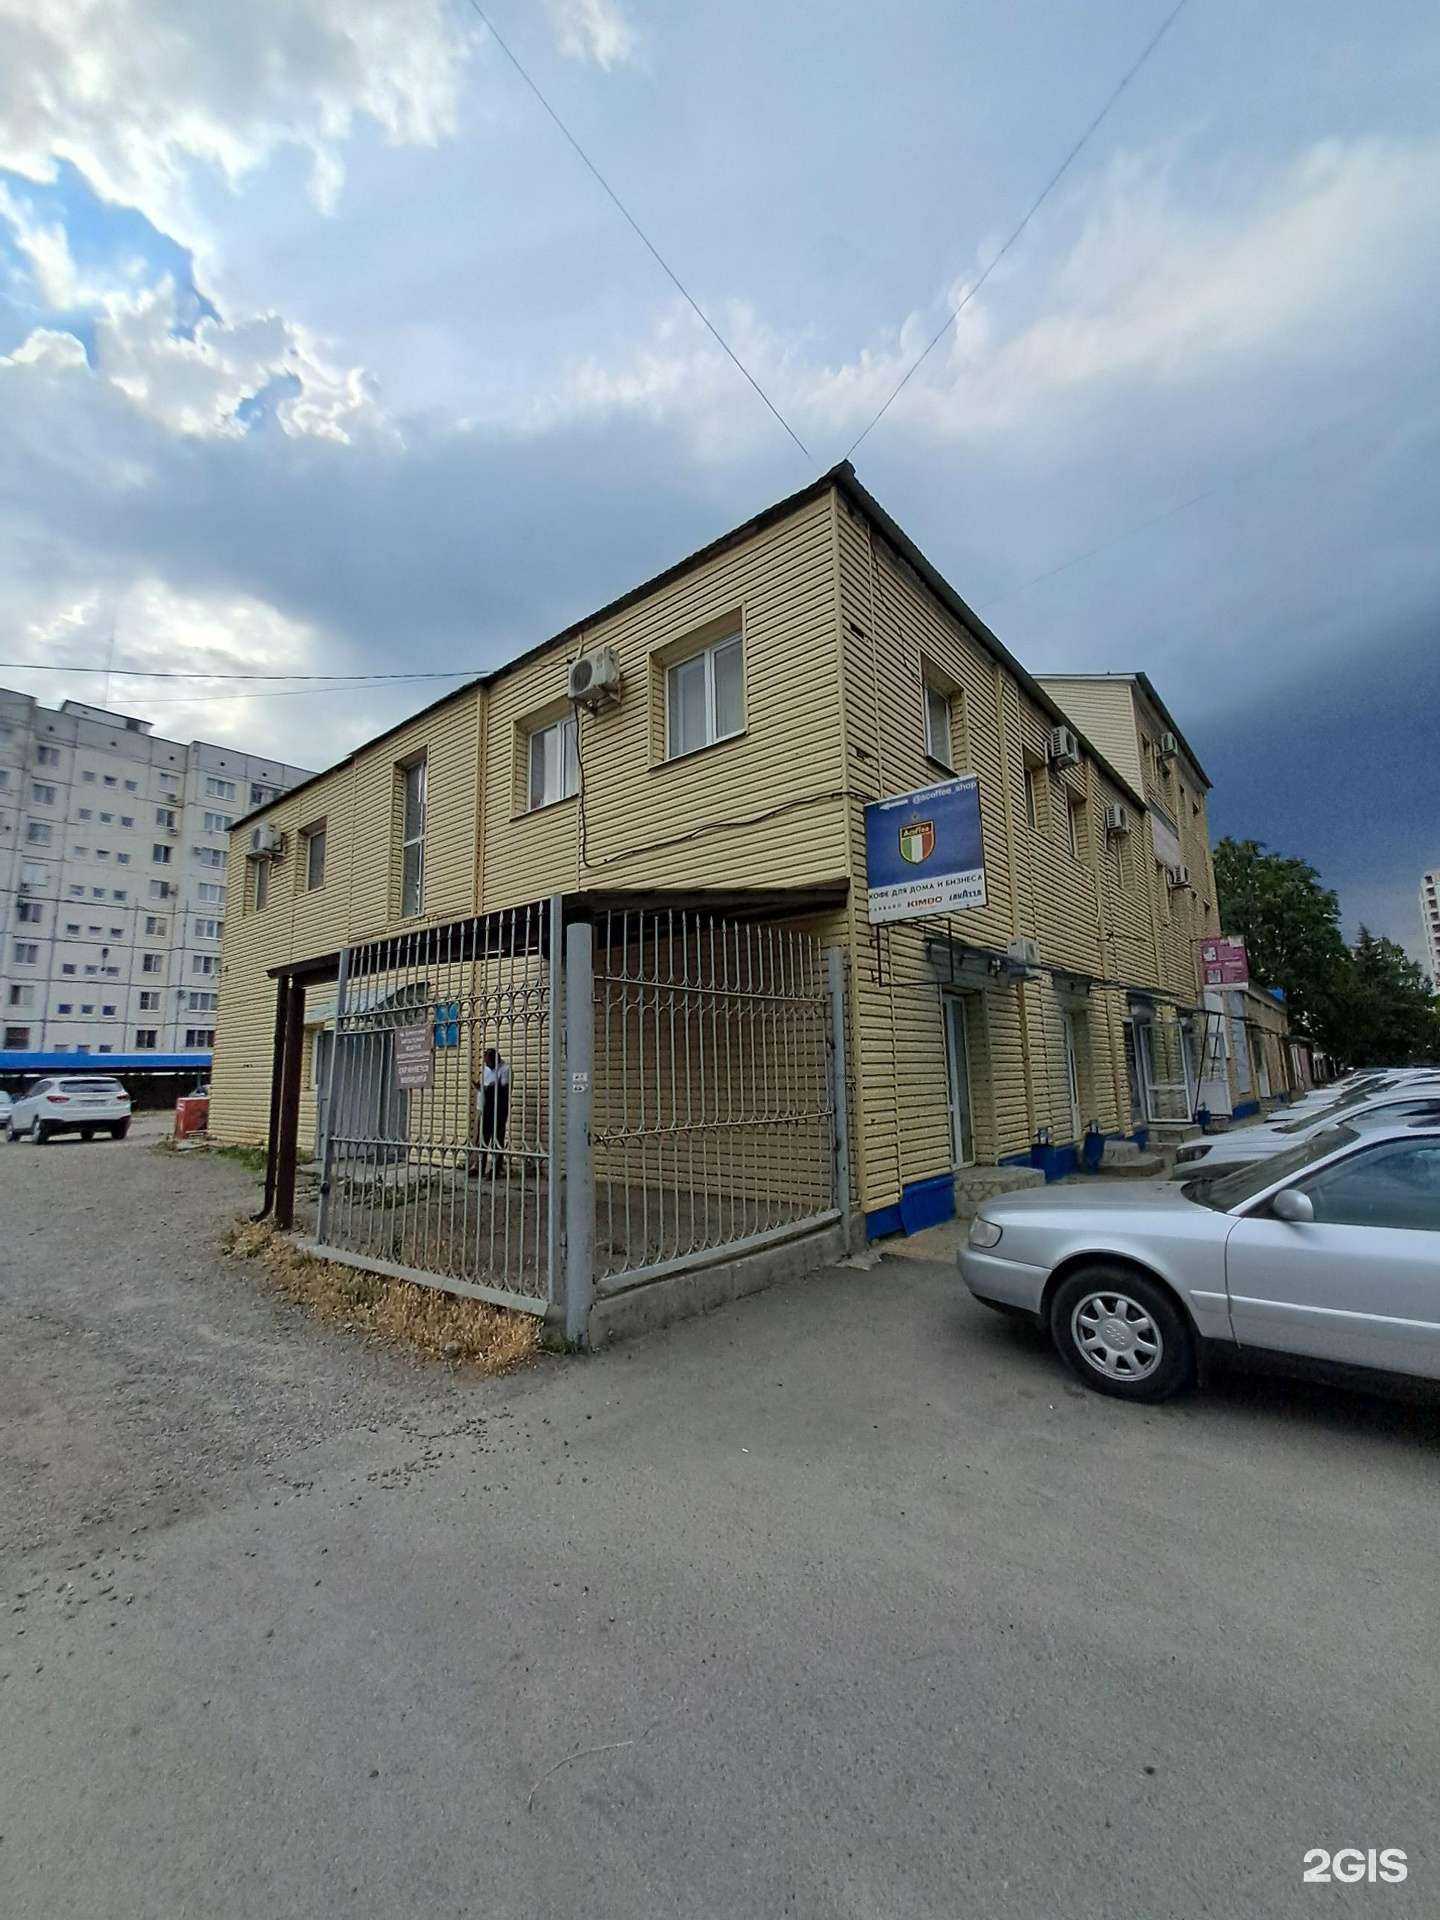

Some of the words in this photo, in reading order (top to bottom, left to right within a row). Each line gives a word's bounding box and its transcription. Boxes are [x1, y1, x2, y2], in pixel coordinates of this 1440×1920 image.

[909, 883, 935, 894] ДОМА
[937, 881, 943, 889] И
[945, 874, 983, 887] БИЗНЕСА
